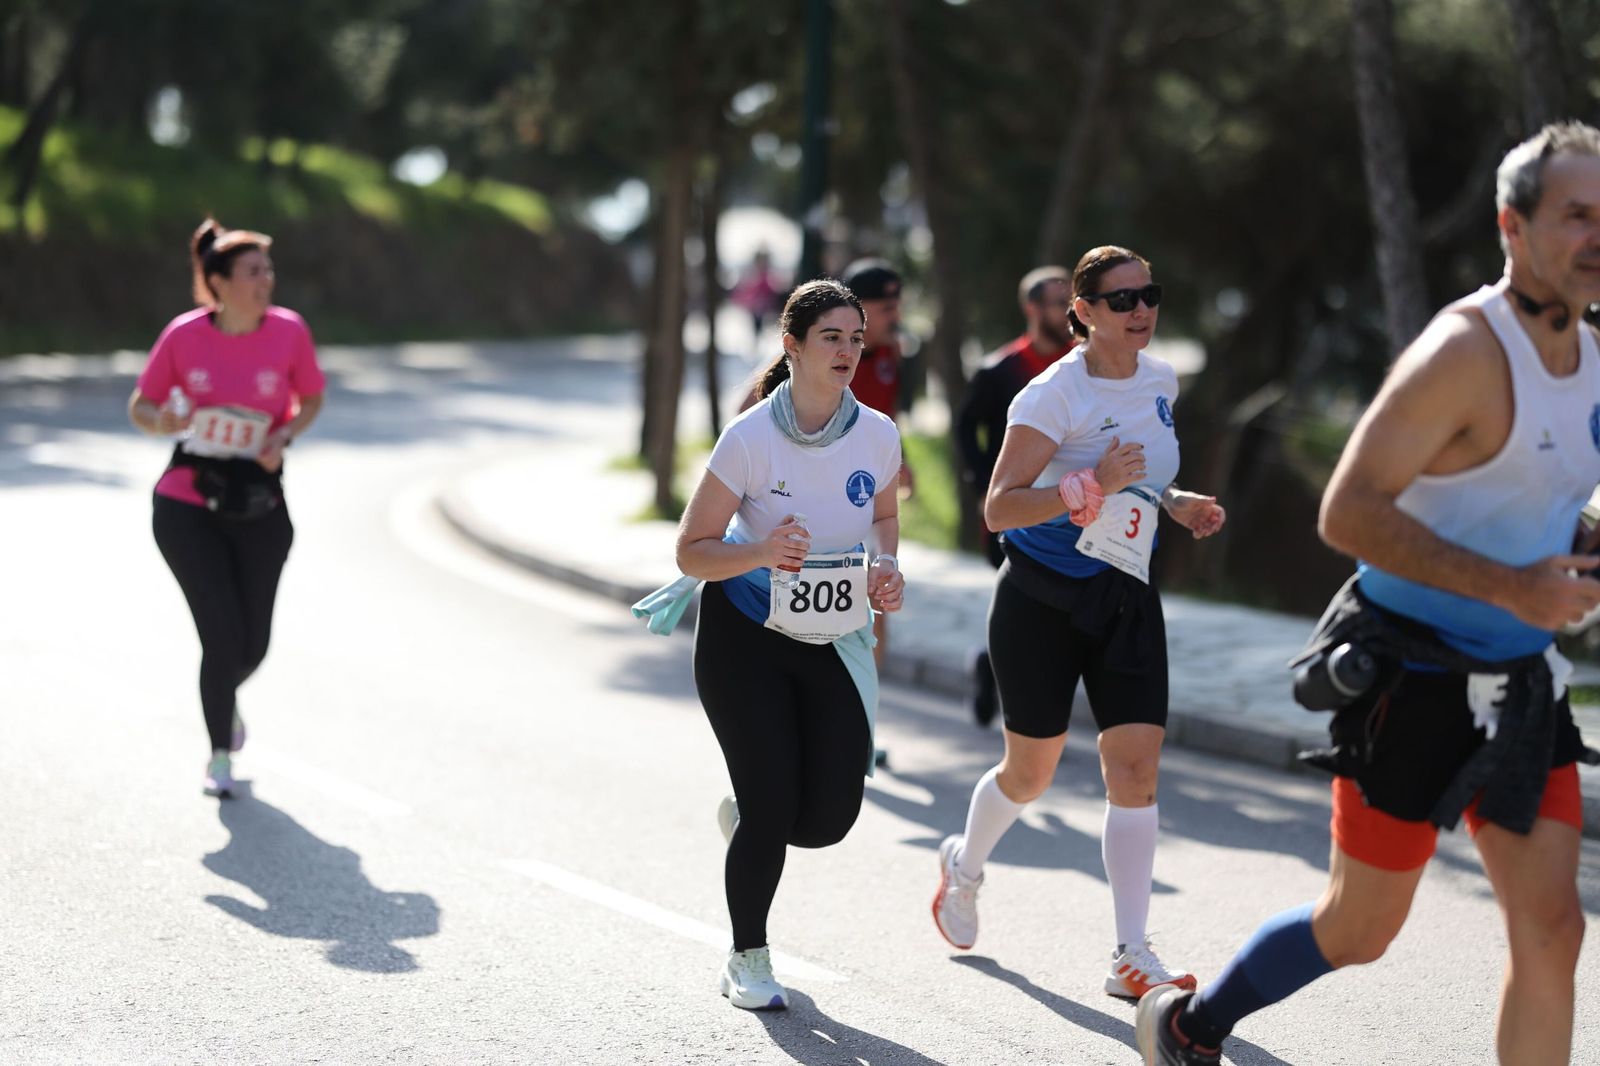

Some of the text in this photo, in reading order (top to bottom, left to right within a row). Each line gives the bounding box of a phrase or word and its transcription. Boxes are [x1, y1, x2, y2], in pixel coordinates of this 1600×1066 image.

[770, 489, 792, 497] SPALL
[1126, 507, 1141, 539] 3
[790, 579, 852, 613] 808
